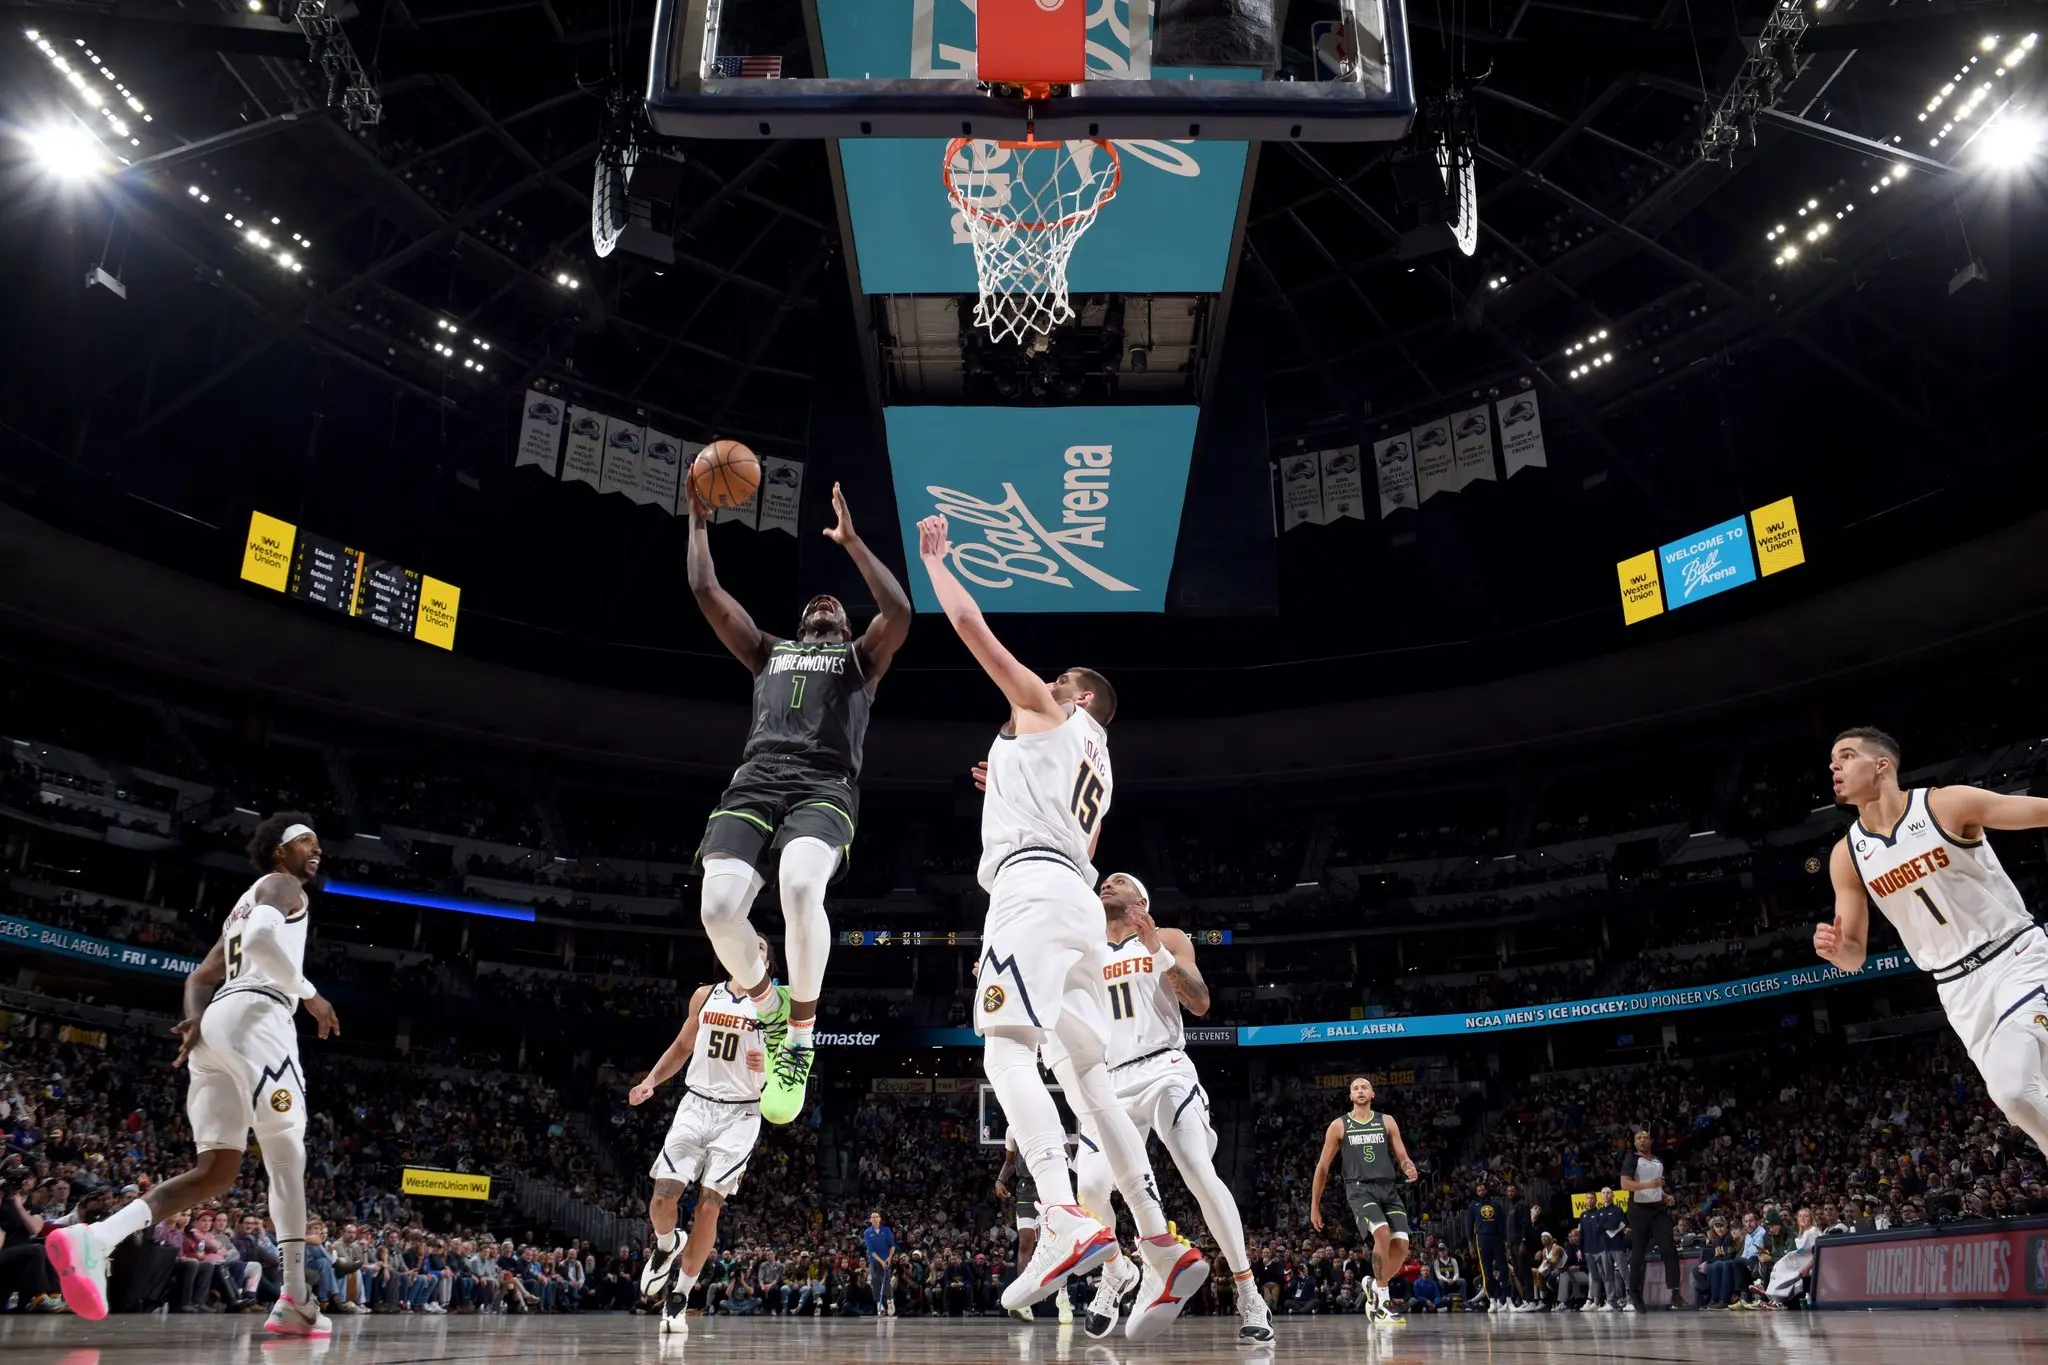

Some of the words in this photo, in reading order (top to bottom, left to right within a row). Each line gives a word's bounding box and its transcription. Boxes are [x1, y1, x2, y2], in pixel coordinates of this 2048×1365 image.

[1049, 444, 1113, 548] Arena
[926, 482, 1074, 588] Ball
[1666, 534, 1724, 564] WELCOME
[1729, 527, 1743, 541] TO
[1758, 527, 1798, 547] Western
[1766, 538, 1793, 553] Union
[250, 541, 289, 562] Western
[254, 553, 281, 569] Union
[1682, 549, 1722, 588] Ball
[1700, 566, 1736, 586] Arena
[1623, 580, 1657, 597] Western
[1630, 590, 1653, 603] Union
[421, 603, 455, 622] Western
[425, 613, 449, 628] Union
[769, 654, 846, 676] TIMBERWOLVES
[790, 675, 807, 708] 1
[1070, 759, 1105, 835] 15
[1868, 846, 1951, 898] NUGGETS
[1913, 886, 1949, 926] 1
[40, 931, 69, 949] BALL
[70, 938, 110, 958] ARENA
[122, 950, 147, 965] FRI
[229, 932, 243, 980] 5
[1103, 956, 1153, 981] GGETS
[1108, 982, 1134, 1020] 11
[1465, 1016, 1501, 1028] NCAA
[1505, 1010, 1545, 1024] MEN'S
[1548, 1007, 1568, 1019] ICE
[1572, 1000, 1628, 1017] HOCKEY:
[1631, 998, 1648, 1010] DU
[1651, 992, 1702, 1008] PIONEER
[1704, 989, 1721, 1000] VS.
[1725, 985, 1740, 997] CC
[1741, 977, 1780, 995] TIGERS
[1792, 972, 1820, 986] BALL
[1876, 956, 1900, 970] FRI
[703, 1011, 759, 1032] NUGGETS
[1326, 1027, 1358, 1037] BALL
[1361, 1022, 1406, 1035] ARENA
[708, 1030, 740, 1062] 50
[1183, 1032, 1197, 1040] NG
[1200, 1032, 1230, 1041] EVENTS
[1348, 1133, 1385, 1145] TIMBERWOLVES
[1363, 1145, 1376, 1162] 5
[1866, 1248, 1913, 1295] WATCH
[1914, 1244, 1949, 1294] LIVE
[1952, 1240, 2011, 1294] GAMES
